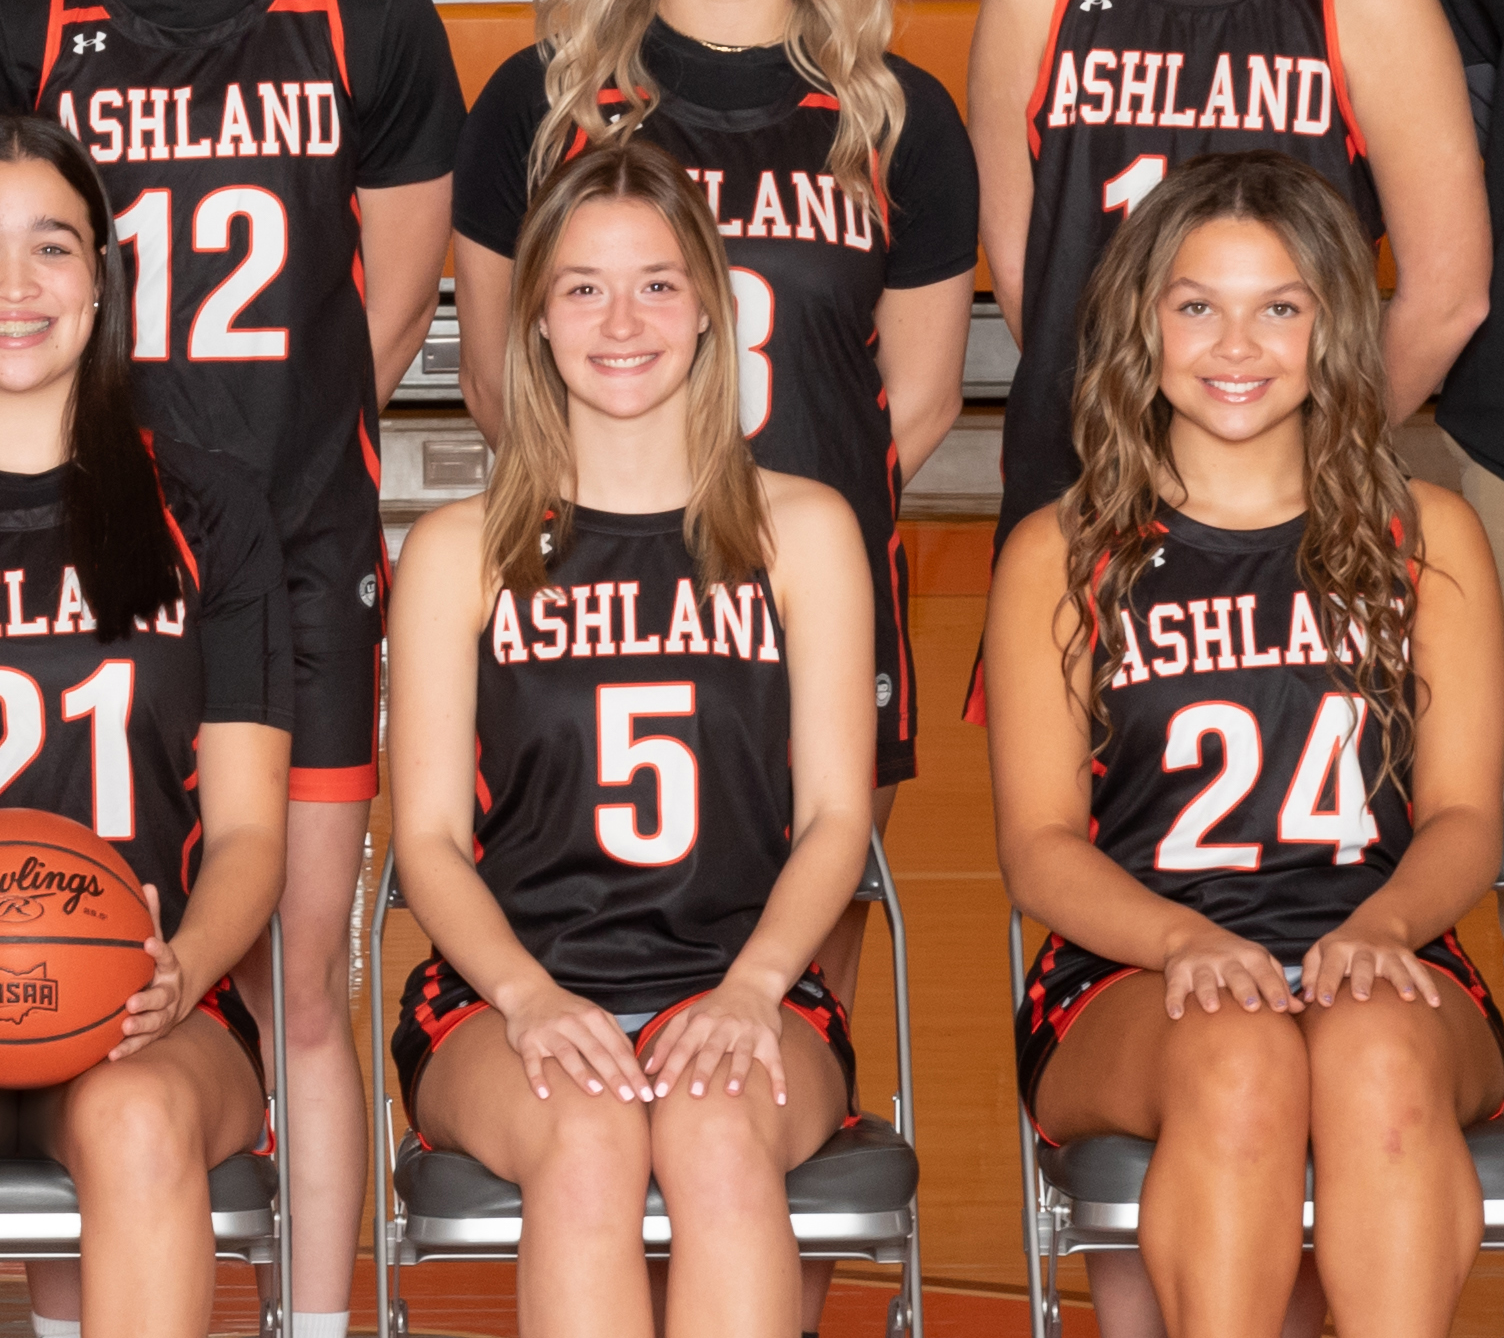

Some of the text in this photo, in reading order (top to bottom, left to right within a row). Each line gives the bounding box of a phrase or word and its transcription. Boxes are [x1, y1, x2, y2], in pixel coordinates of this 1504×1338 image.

[1048, 48, 1332, 136] ASHLAND
[113, 184, 289, 361] 12
[1111, 590, 1411, 690] ASHLAN
[594, 680, 699, 868] 5
[1153, 691, 1380, 872] 24
